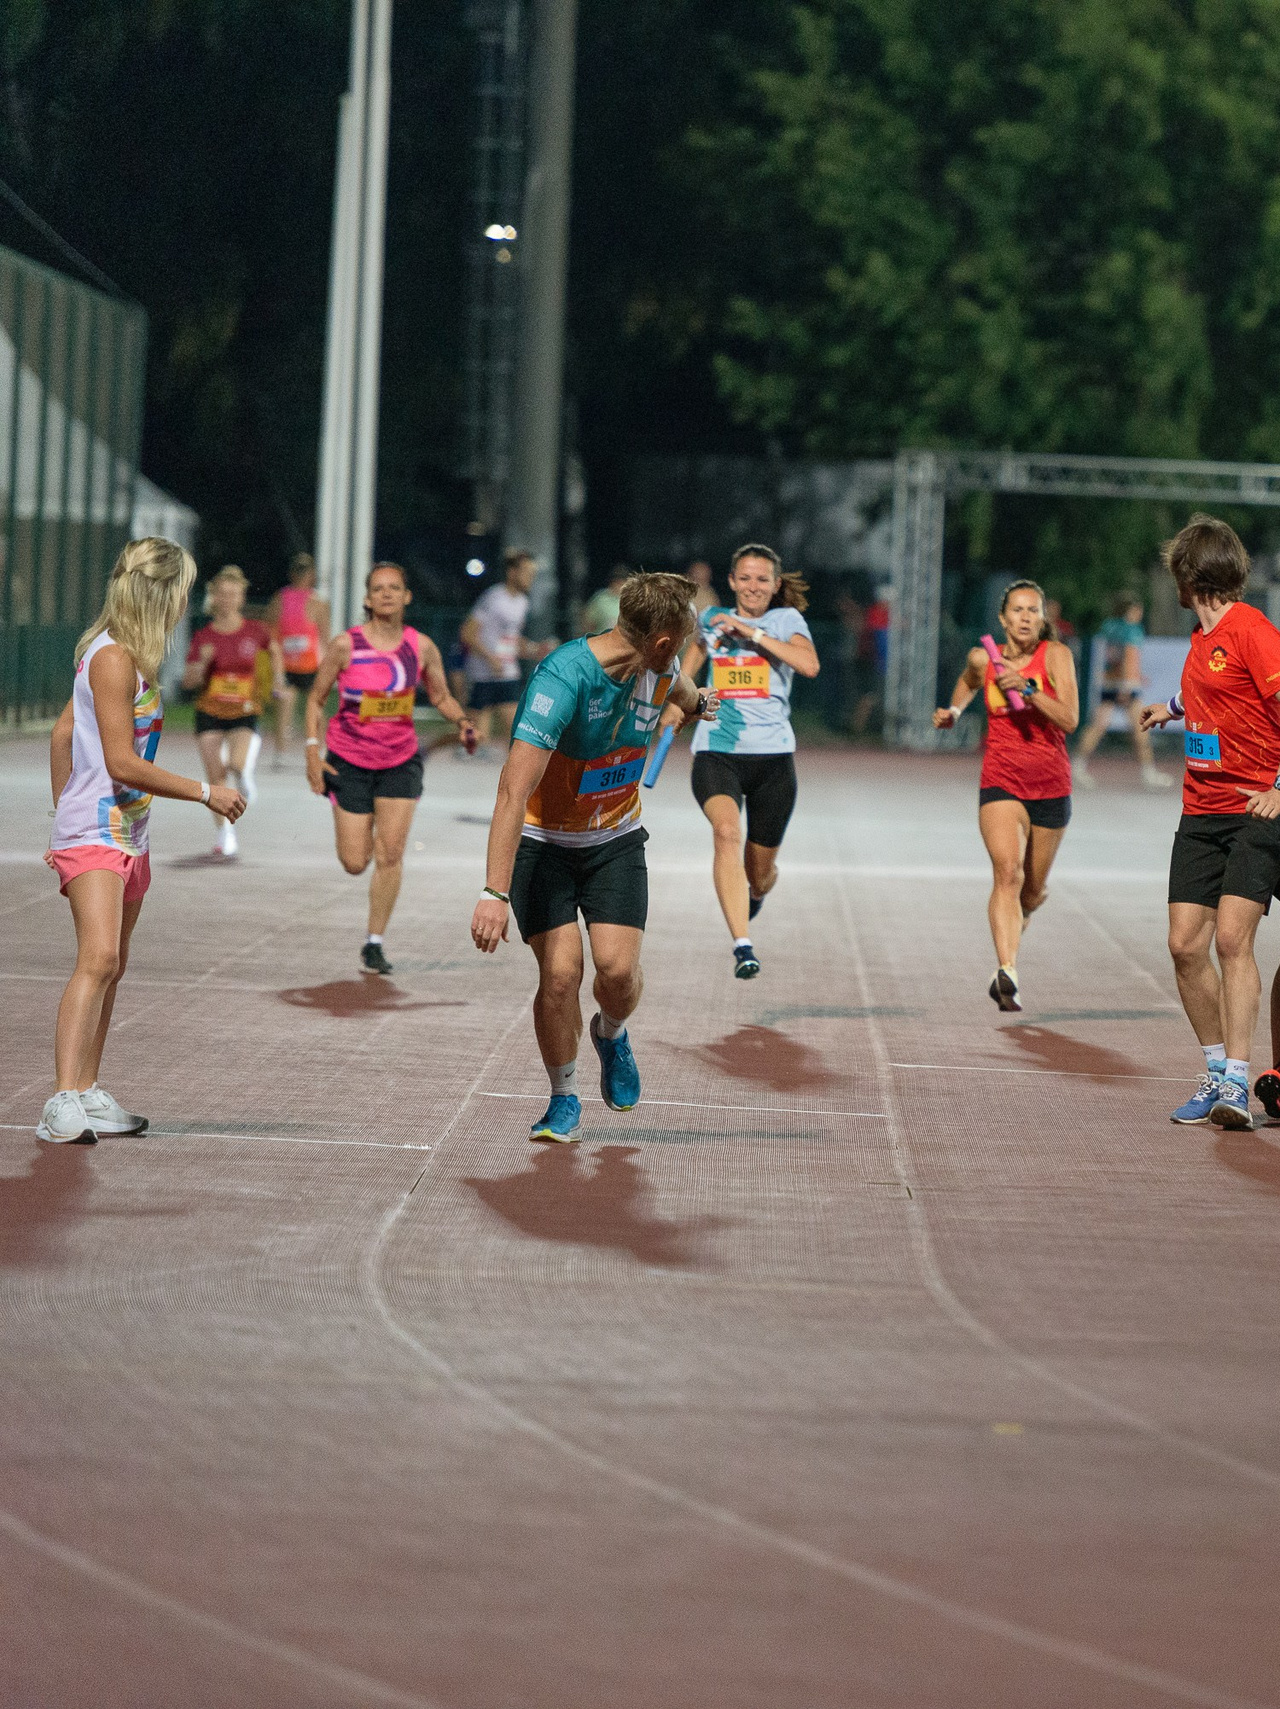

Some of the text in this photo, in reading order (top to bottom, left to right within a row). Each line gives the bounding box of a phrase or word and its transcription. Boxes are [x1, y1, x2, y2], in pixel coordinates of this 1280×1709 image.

[728, 670, 752, 685] 316
[1189, 737, 1214, 756] 315 3
[600, 767, 626, 787] 316
